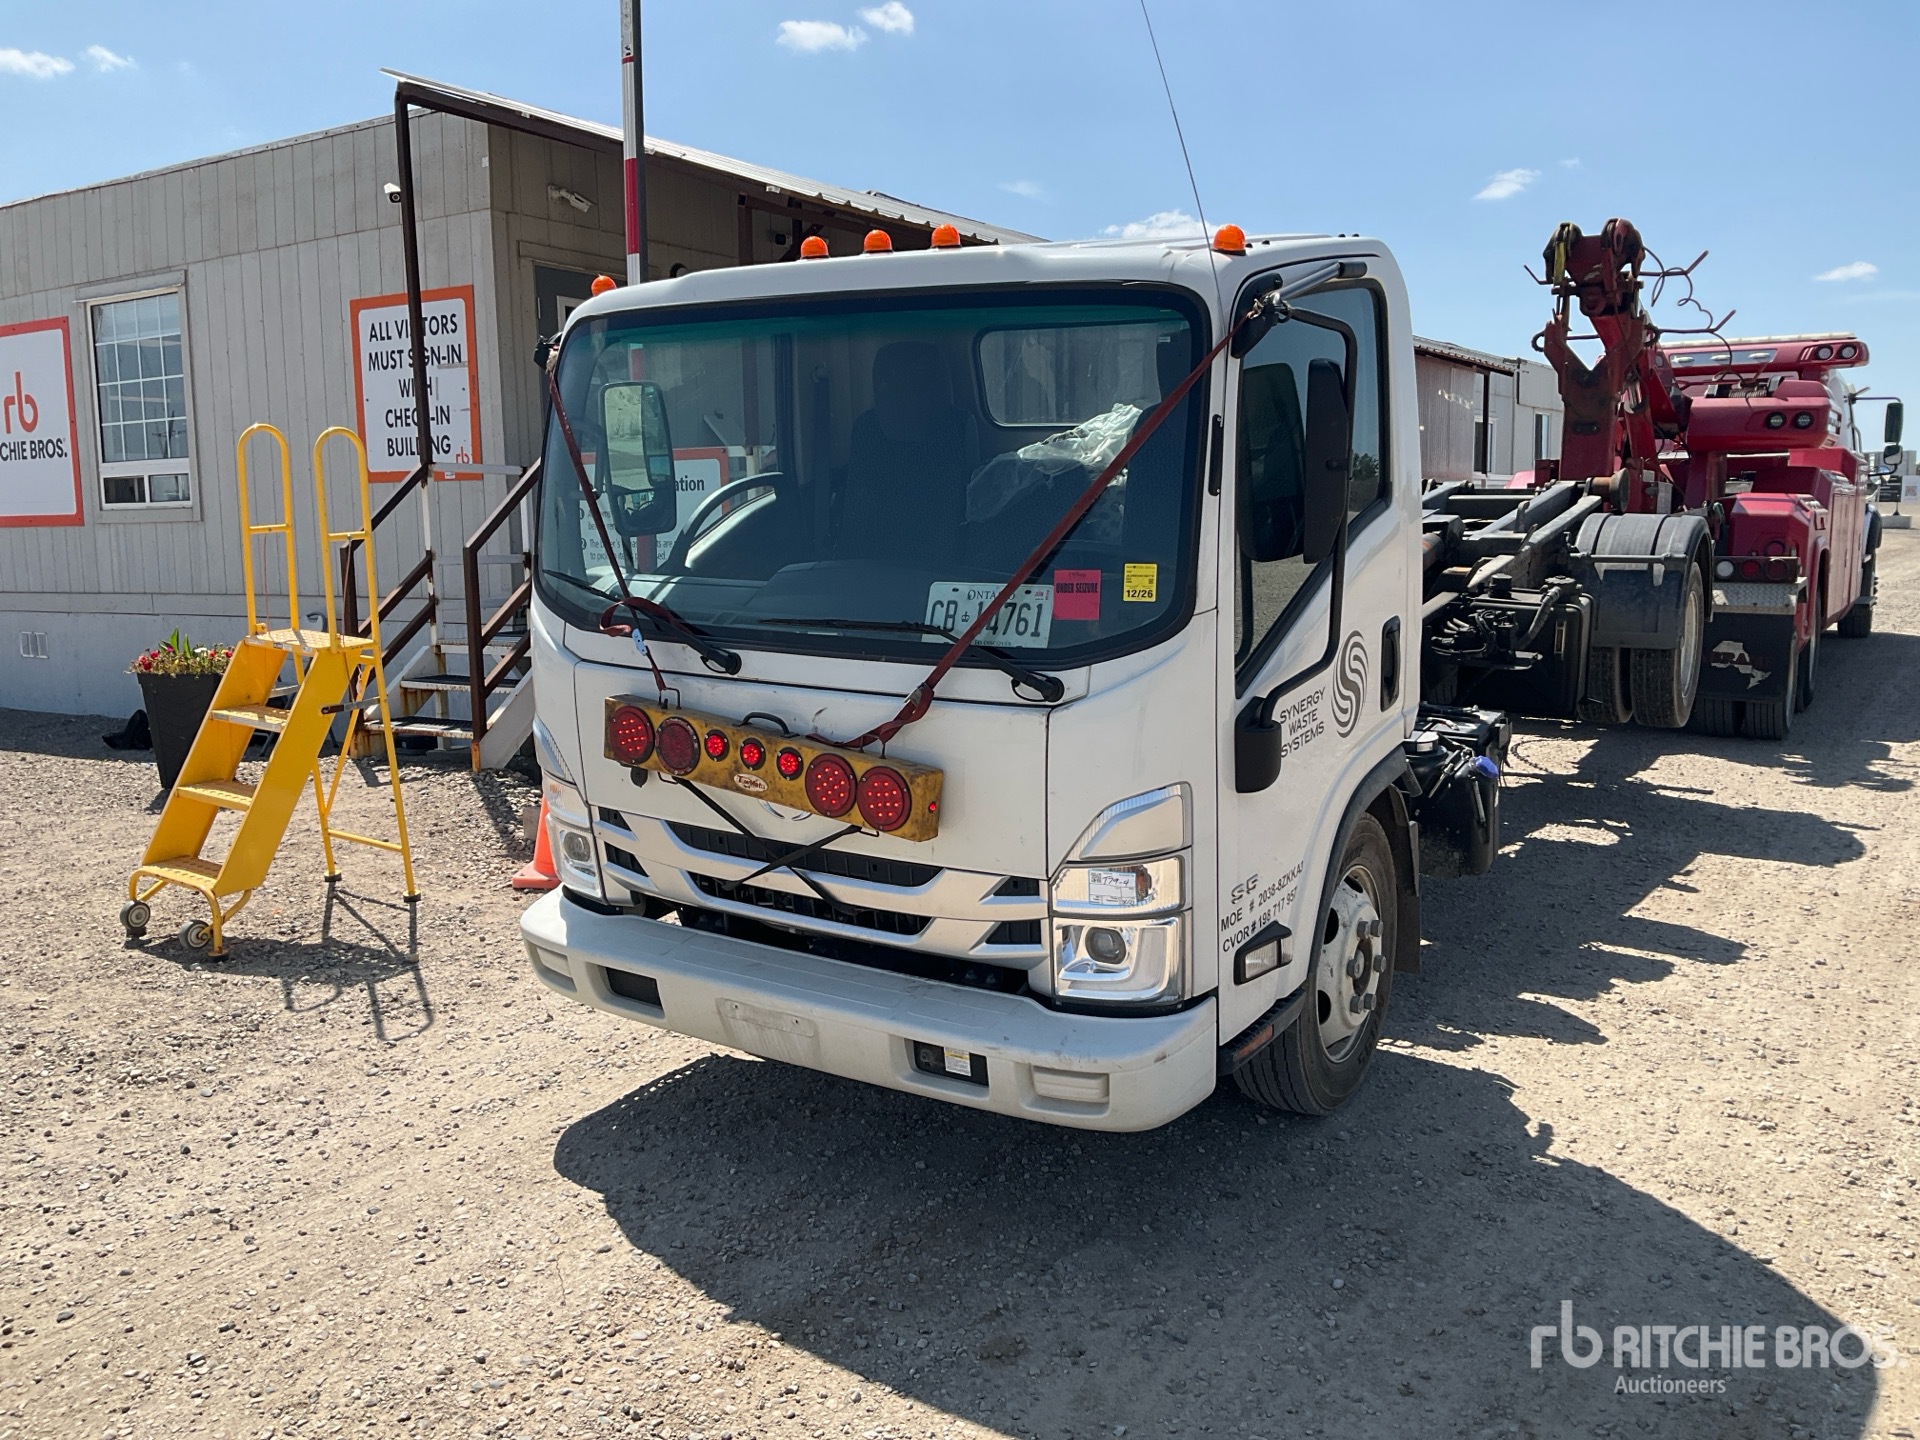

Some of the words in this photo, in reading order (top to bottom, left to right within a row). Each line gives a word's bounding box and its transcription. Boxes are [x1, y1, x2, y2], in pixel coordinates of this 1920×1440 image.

[369, 321, 392, 342] ALL
[394, 313, 458, 339] VITORS
[368, 349, 404, 371] MUST
[408, 343, 462, 368] SGN-IN
[398, 376, 432, 398] WIH
[385, 405, 450, 428] CHEC-IN
[29, 437, 68, 460] BROS.
[387, 434, 451, 457] BUILNG
[1055, 582, 1075, 594] UNDER
[1075, 582, 1098, 594] SEIZURE
[1126, 589, 1153, 598] 12/26
[1280, 686, 1325, 725] SYNERGY
[1288, 708, 1318, 736] WASTE
[1280, 721, 1325, 758] SYSTEMS
[1220, 907, 1243, 932] MOE
